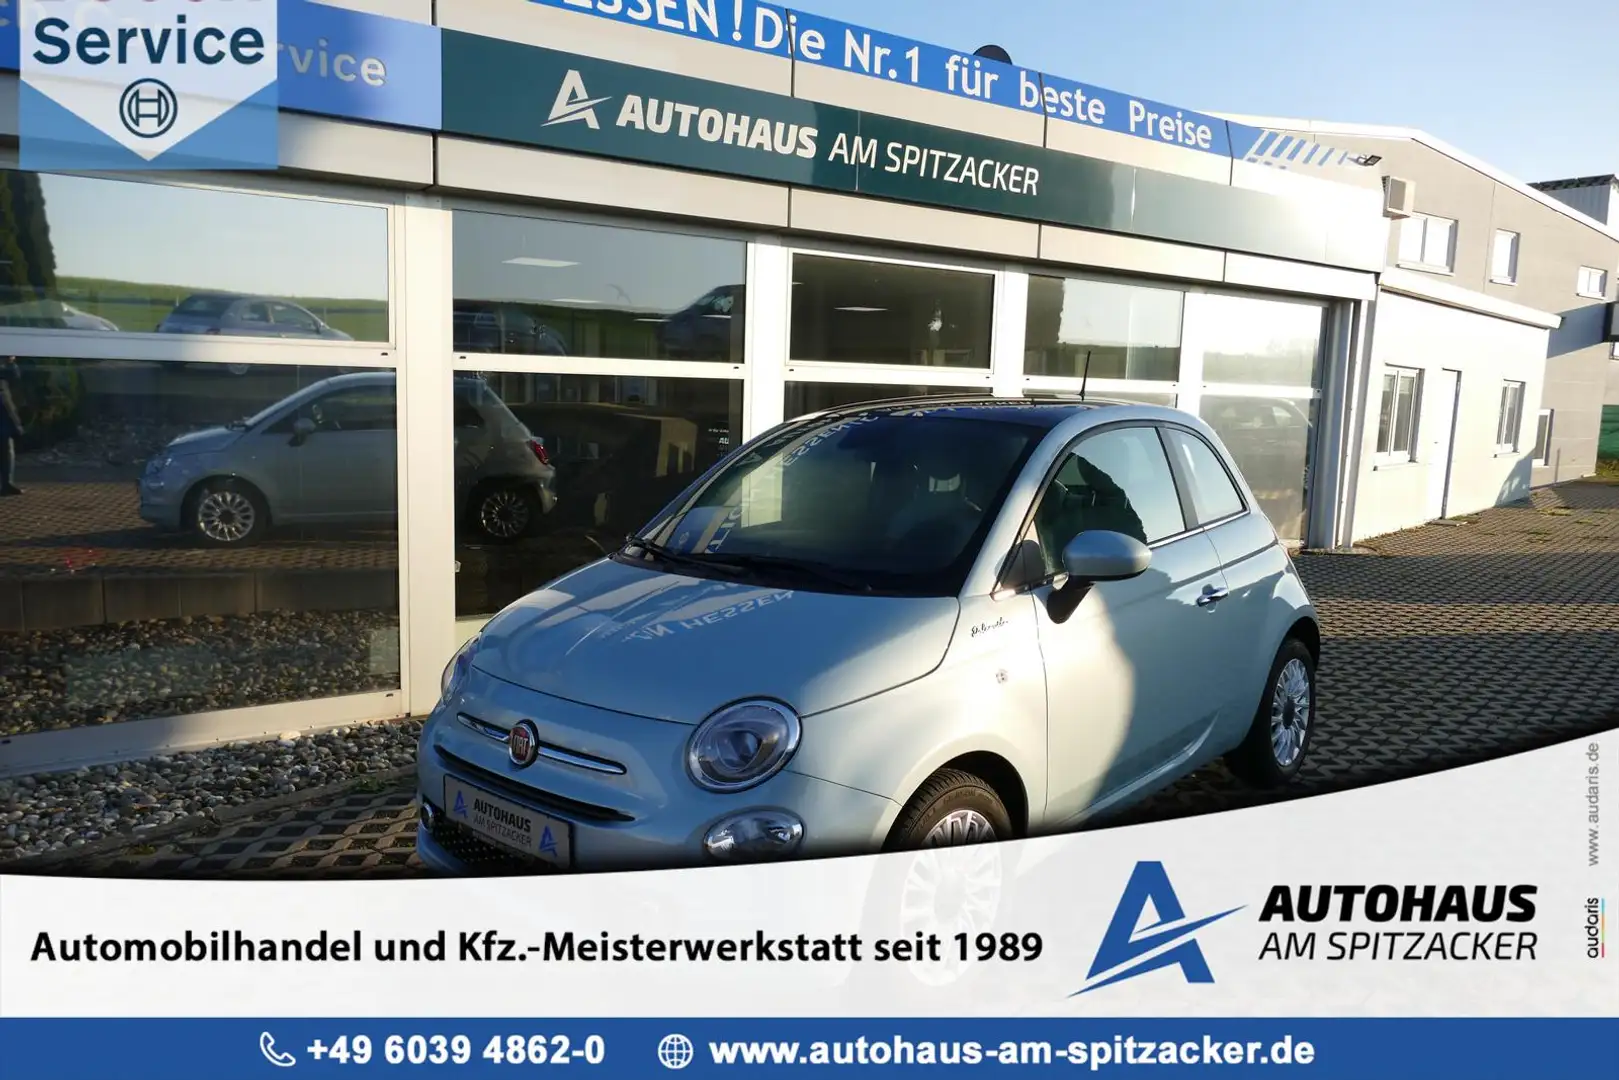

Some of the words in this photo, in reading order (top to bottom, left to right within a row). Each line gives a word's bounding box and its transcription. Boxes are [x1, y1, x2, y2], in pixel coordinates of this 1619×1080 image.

[754, 7, 826, 60] Die
[843, 28, 919, 83] Nr.1
[945, 54, 999, 99] für
[1020, 71, 1106, 125] beste
[1129, 100, 1212, 150] Preise
[616, 94, 818, 159] AUTOHAUS
[828, 131, 877, 168] AM
[884, 142, 1040, 196] SPITZACKER
[473, 798, 531, 832] AUTOHAUS
[486, 821, 532, 847] SPITZACKER
